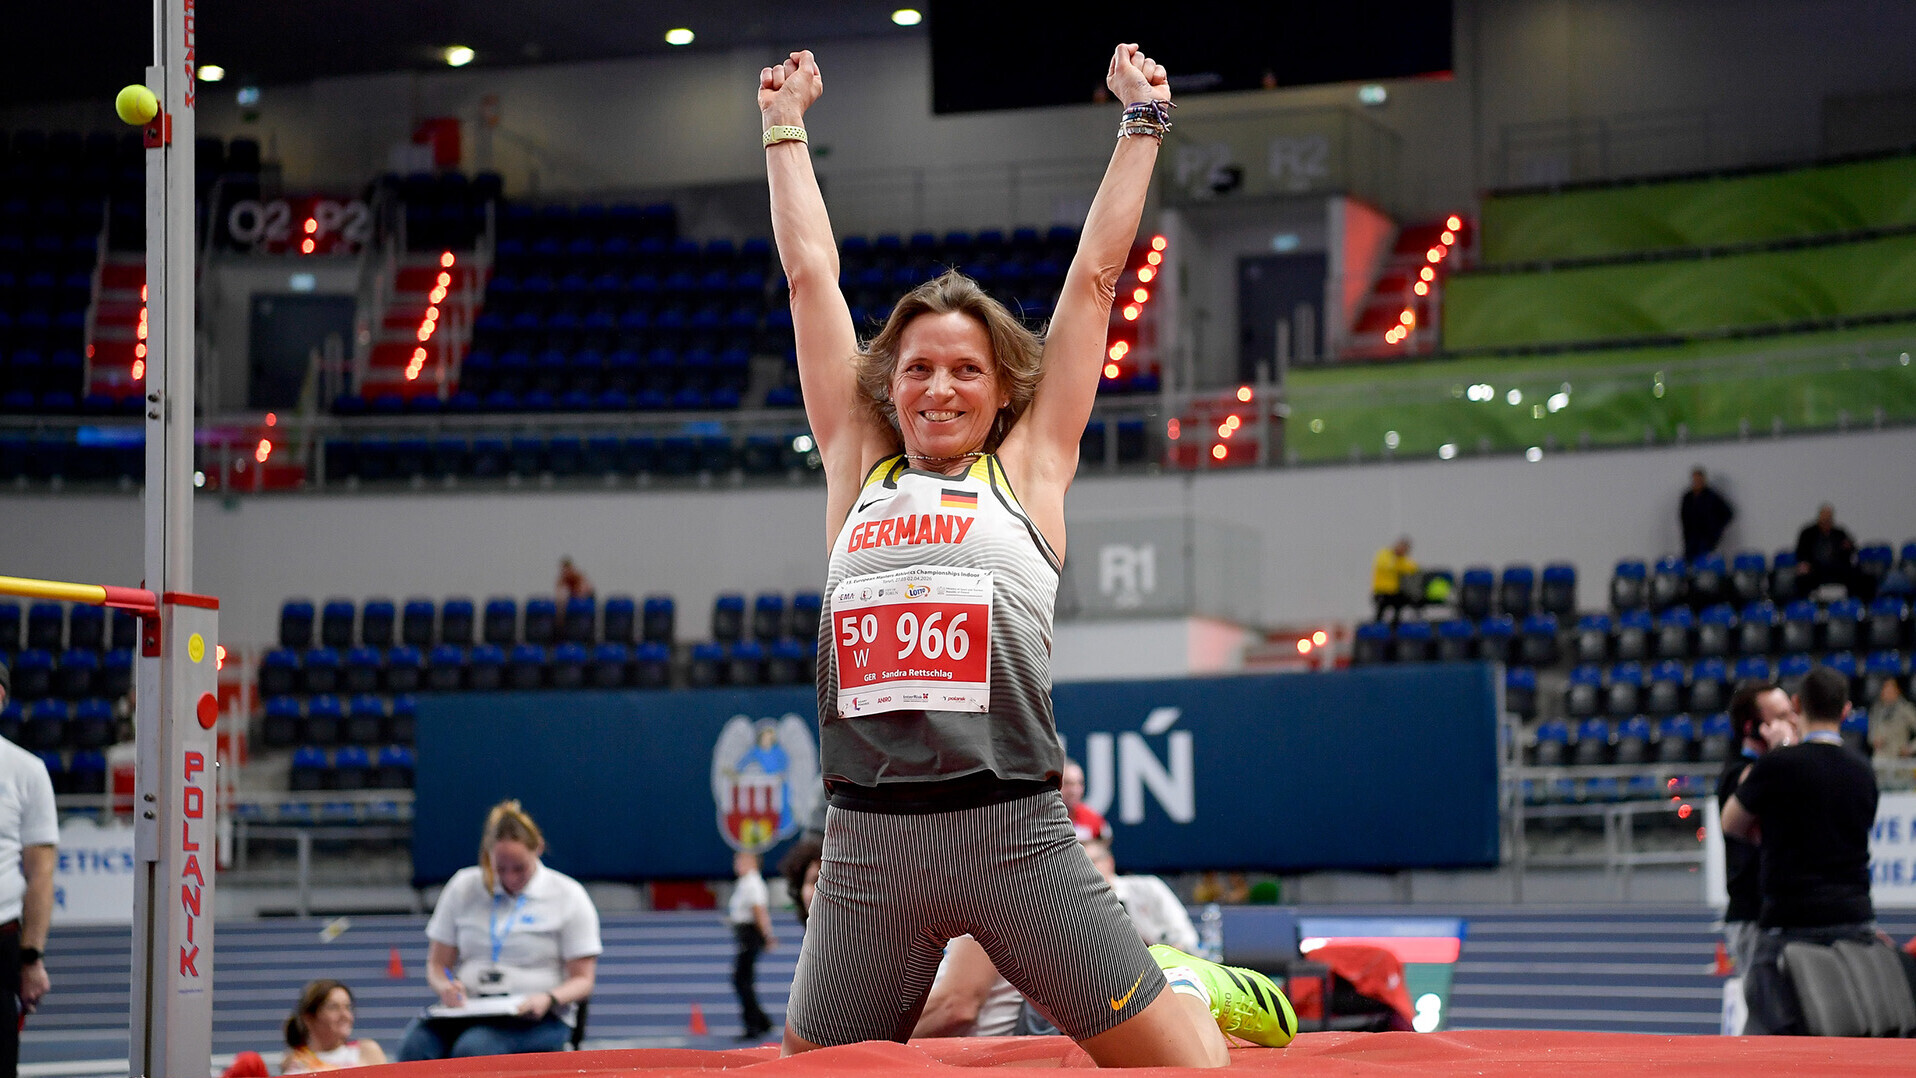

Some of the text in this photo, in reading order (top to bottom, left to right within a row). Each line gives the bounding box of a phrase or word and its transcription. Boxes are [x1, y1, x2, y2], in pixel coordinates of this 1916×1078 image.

[848, 514, 975, 553] GERMANY
[917, 569, 960, 577] Championships
[1100, 543, 1156, 595] R1
[909, 587, 926, 597] LOTTO
[842, 611, 970, 661] 50 966
[853, 648, 870, 669] W
[864, 669, 953, 682] GER Sandra Rettschlag
[179, 751, 205, 977] POLANIK
